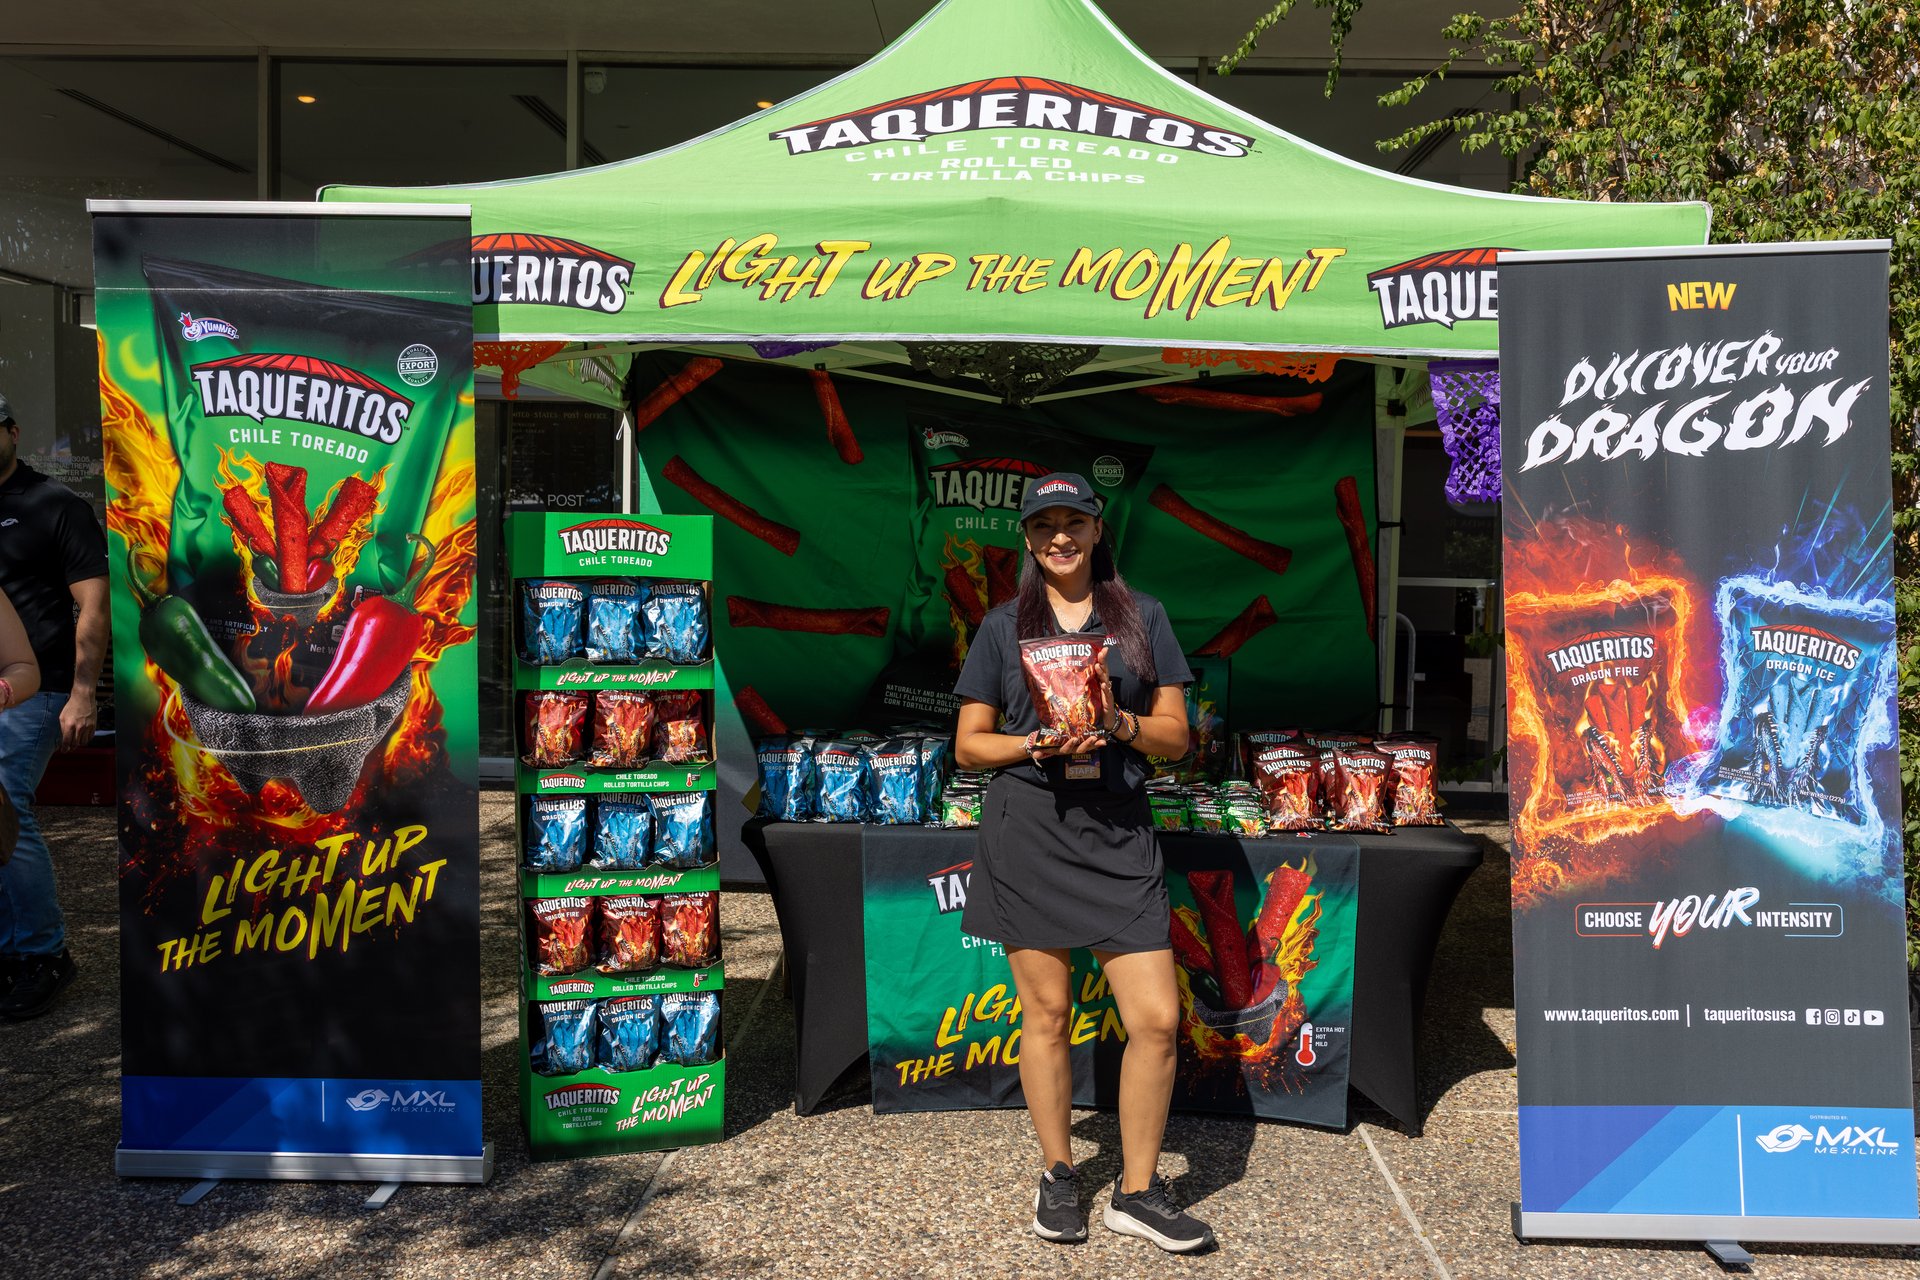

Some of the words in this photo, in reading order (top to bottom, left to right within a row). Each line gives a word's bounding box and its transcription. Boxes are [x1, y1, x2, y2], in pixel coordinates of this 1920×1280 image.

[781, 90, 1250, 157] TAQUERITOS
[845, 137, 966, 163] CHILE
[999, 136, 1178, 165] TOREADO
[940, 157, 1072, 171] ROLLED
[866, 168, 1034, 184] TORTILLA
[1045, 170, 1146, 186] CHIPS
[660, 232, 871, 308] LIGHT
[861, 252, 955, 301] UP
[966, 253, 1055, 295] THE
[1060, 235, 1347, 320] MOMENT
[1667, 281, 1737, 312] NEW
[400, 361, 435, 369] EXPORT
[1558, 329, 1783, 408] DISCOVER
[1775, 346, 1840, 377] YOUR
[194, 370, 409, 444] TAQUERITOS
[1518, 376, 1874, 474] DRAGON
[230, 429, 281, 444] CHILE
[290, 431, 369, 463] TOREADO
[1037, 483, 1078, 496] TAQUERITOS
[547, 494, 585, 507] POST
[955, 517, 998, 530] CHILE
[561, 528, 670, 556] TAQUERITOS
[579, 556, 606, 567] CHILE
[611, 556, 652, 567] TOREADO
[530, 587, 583, 602] TAQUERITOS
[650, 584, 700, 596] TAQUERITOS
[309, 644, 325, 653] Net
[1029, 644, 1092, 664] TAQUERITOS
[1548, 635, 1654, 673] TAQUERITOS
[1751, 629, 1860, 670] TAQUERITOS
[1042, 661, 1067, 672] DRAGON
[1767, 659, 1813, 675] DRAGON
[1815, 666, 1836, 682] ICE
[556, 671, 594, 686] LIGHT
[593, 673, 610, 683] UP
[628, 670, 678, 686] MOMENT
[1571, 667, 1611, 686] DRAGON
[1614, 665, 1639, 678] FIRE
[886, 684, 921, 695] NATURALLY
[631, 696, 645, 704] FIRE
[883, 698, 900, 706] CORN
[902, 701, 932, 712] TORTILLA
[934, 707, 953, 715] CHIPS
[885, 691, 902, 700] CHILI
[903, 694, 935, 705] FLAVORED
[936, 700, 960, 709] ROLLED
[758, 752, 802, 763] TAQUERITOS
[815, 754, 860, 766] TAQUERITOS
[870, 755, 917, 770] TAQUERITOS
[1338, 757, 1386, 770] TAQUERITOS
[1068, 765, 1096, 775] STAFF
[1262, 760, 1311, 775] TAQUERITOS
[540, 776, 586, 789] TAQUERITOS
[535, 799, 586, 812] TAQUERITOS
[652, 791, 702, 809] TAQUERITOS
[201, 832, 355, 924] LIGHT
[360, 824, 428, 876] UP
[564, 878, 600, 893] LIGHT
[600, 879, 616, 889] UP
[618, 879, 632, 887] THE
[635, 873, 684, 890] MOMENT
[534, 897, 586, 913] TAQUERITOS
[157, 930, 222, 973] THE
[233, 858, 447, 960] MOMENT
[1584, 911, 1642, 928] CHOOSE
[1649, 886, 1760, 949] YOUR
[1756, 911, 1833, 928] INTENSITY
[641, 975, 666, 983] TOREADO
[661, 982, 677, 990] CHIPS
[549, 982, 594, 995] TAQUERITOS
[548, 1015, 572, 1023] DRAGON
[611, 1015, 634, 1023] DRAGON
[1544, 1007, 1680, 1024] www.taqueritos.com
[1704, 1007, 1796, 1024] taqueritosusa
[895, 1051, 954, 1087] THE
[391, 1090, 456, 1107] MXL
[545, 1089, 620, 1111] TAQUERITOS
[631, 1077, 685, 1114] LIGHT
[686, 1073, 710, 1092] UP
[557, 1107, 577, 1117] CHILE
[615, 1116, 639, 1132] THE
[641, 1084, 716, 1123] MOMENT
[562, 1121, 587, 1129] TORTILLA
[1815, 1125, 1899, 1147] MXL
[1814, 1147, 1899, 1156] MEXILINK
